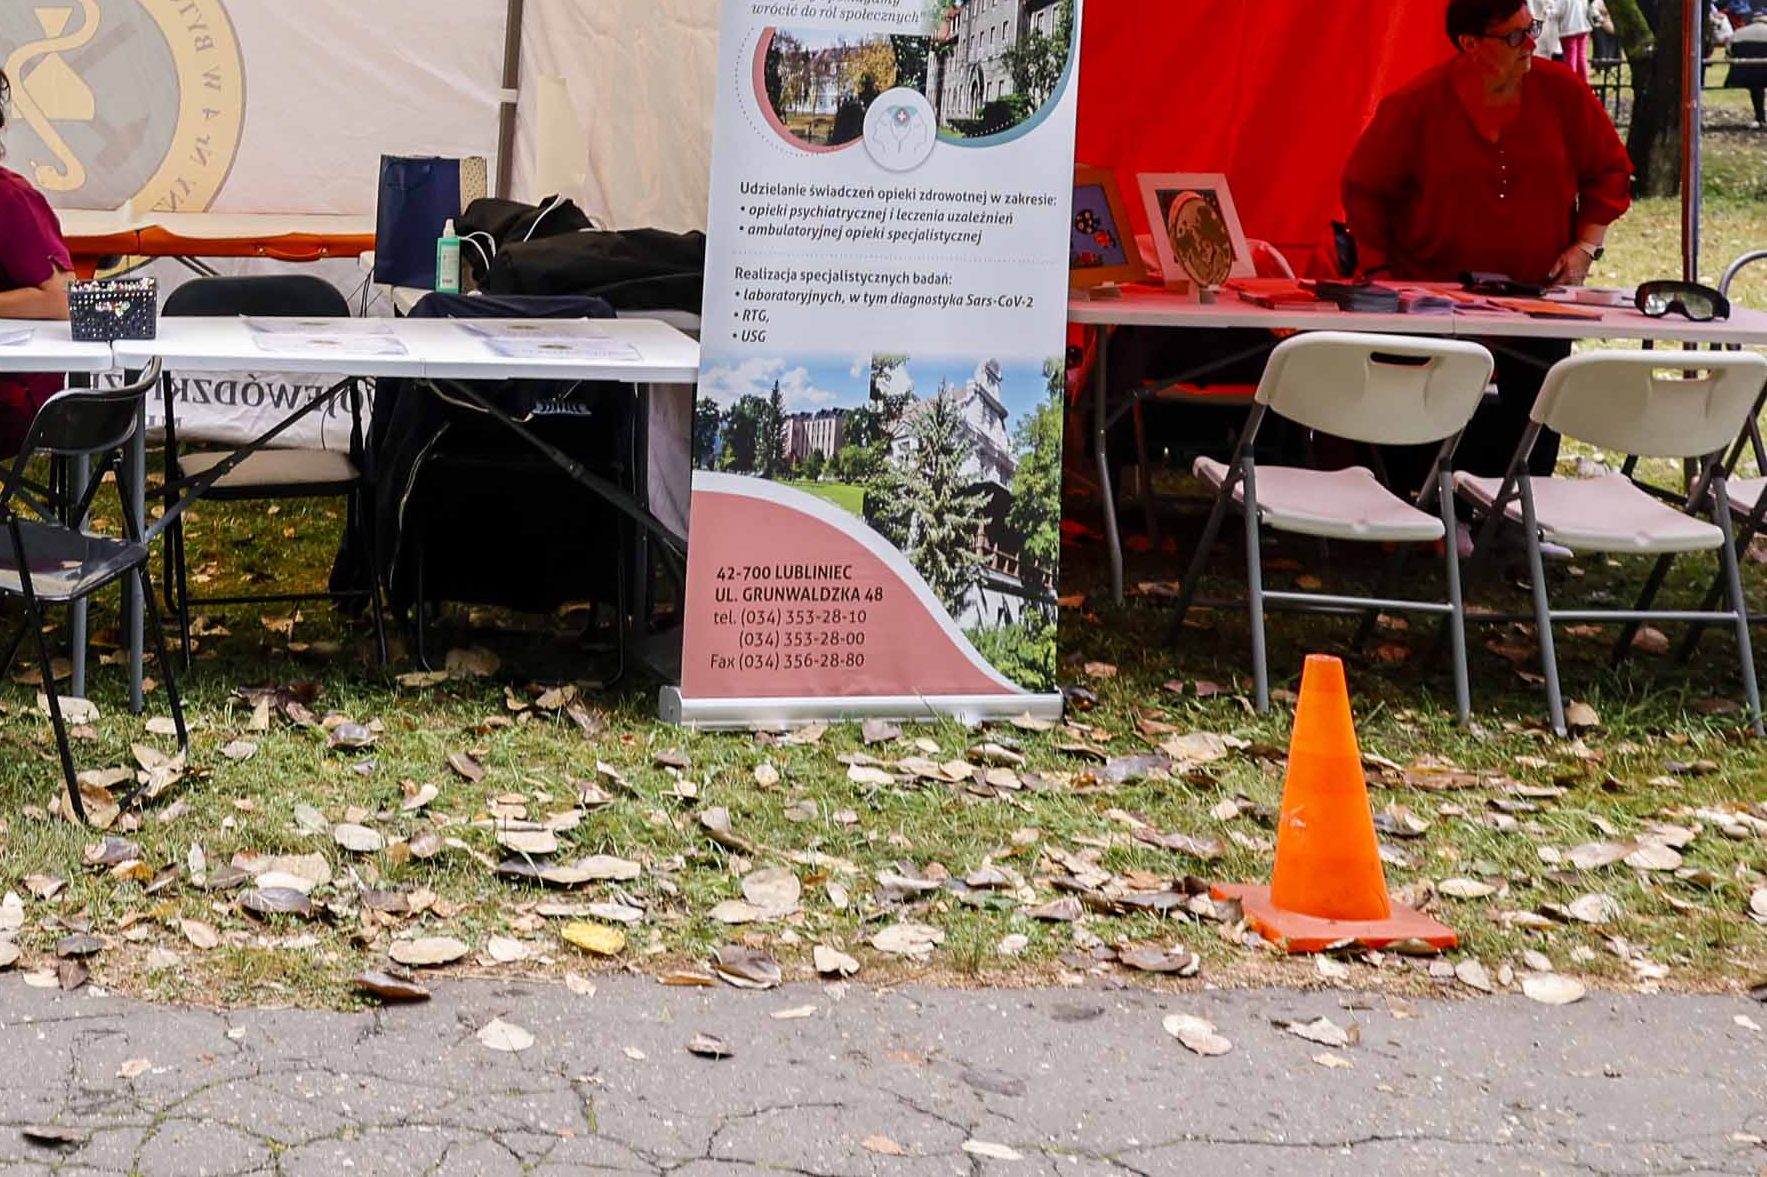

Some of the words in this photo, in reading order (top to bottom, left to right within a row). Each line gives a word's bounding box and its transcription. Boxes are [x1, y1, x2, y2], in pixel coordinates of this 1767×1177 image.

[752, 2, 798, 16] wrócić
[800, 5, 817, 17] do
[819, 6, 837, 18] ról
[740, 182, 807, 197] Udzielanie
[810, 184, 874, 199] świadczeń
[878, 187, 916, 203] opieki
[919, 188, 987, 206] zdrowotnej
[990, 195, 1002, 204] w
[1005, 193, 1057, 207] zakresie:
[749, 204, 787, 219] opieki
[789, 205, 887, 222] psychiatrycznej
[897, 208, 944, 222] leczenia
[948, 211, 1013, 225] uzależnień
[748, 224, 843, 241] ambulatoryjnej
[845, 226, 884, 241] opieki
[887, 228, 983, 246] specjalistycznej
[735, 266, 797, 283] Realizacja
[800, 268, 909, 287] specjalistycznych
[913, 271, 953, 286] badań:
[744, 288, 845, 305] laboratoryjnych,
[849, 294, 861, 303] w
[863, 292, 888, 307] tym
[890, 291, 963, 309] diagnostyka
[966, 294, 1034, 308] Sars-CoV-2
[742, 309, 770, 323] RTG,
[741, 330, 767, 343] USG
[716, 566, 771, 581] 42-700
[775, 565, 853, 580] LUBLINIEC
[715, 587, 738, 602] UL.
[742, 587, 861, 602] GRUNWALDZKA
[864, 587, 884, 602] 48
[713, 610, 737, 625] tel.
[741, 608, 781, 627] (034)
[785, 610, 867, 625] 353-28-10
[739, 630, 780, 648] (034)
[784, 631, 865, 647] 353-28-00
[710, 654, 735, 669] Fax
[739, 652, 780, 670] (034)
[784, 653, 865, 669] 356-28-80
